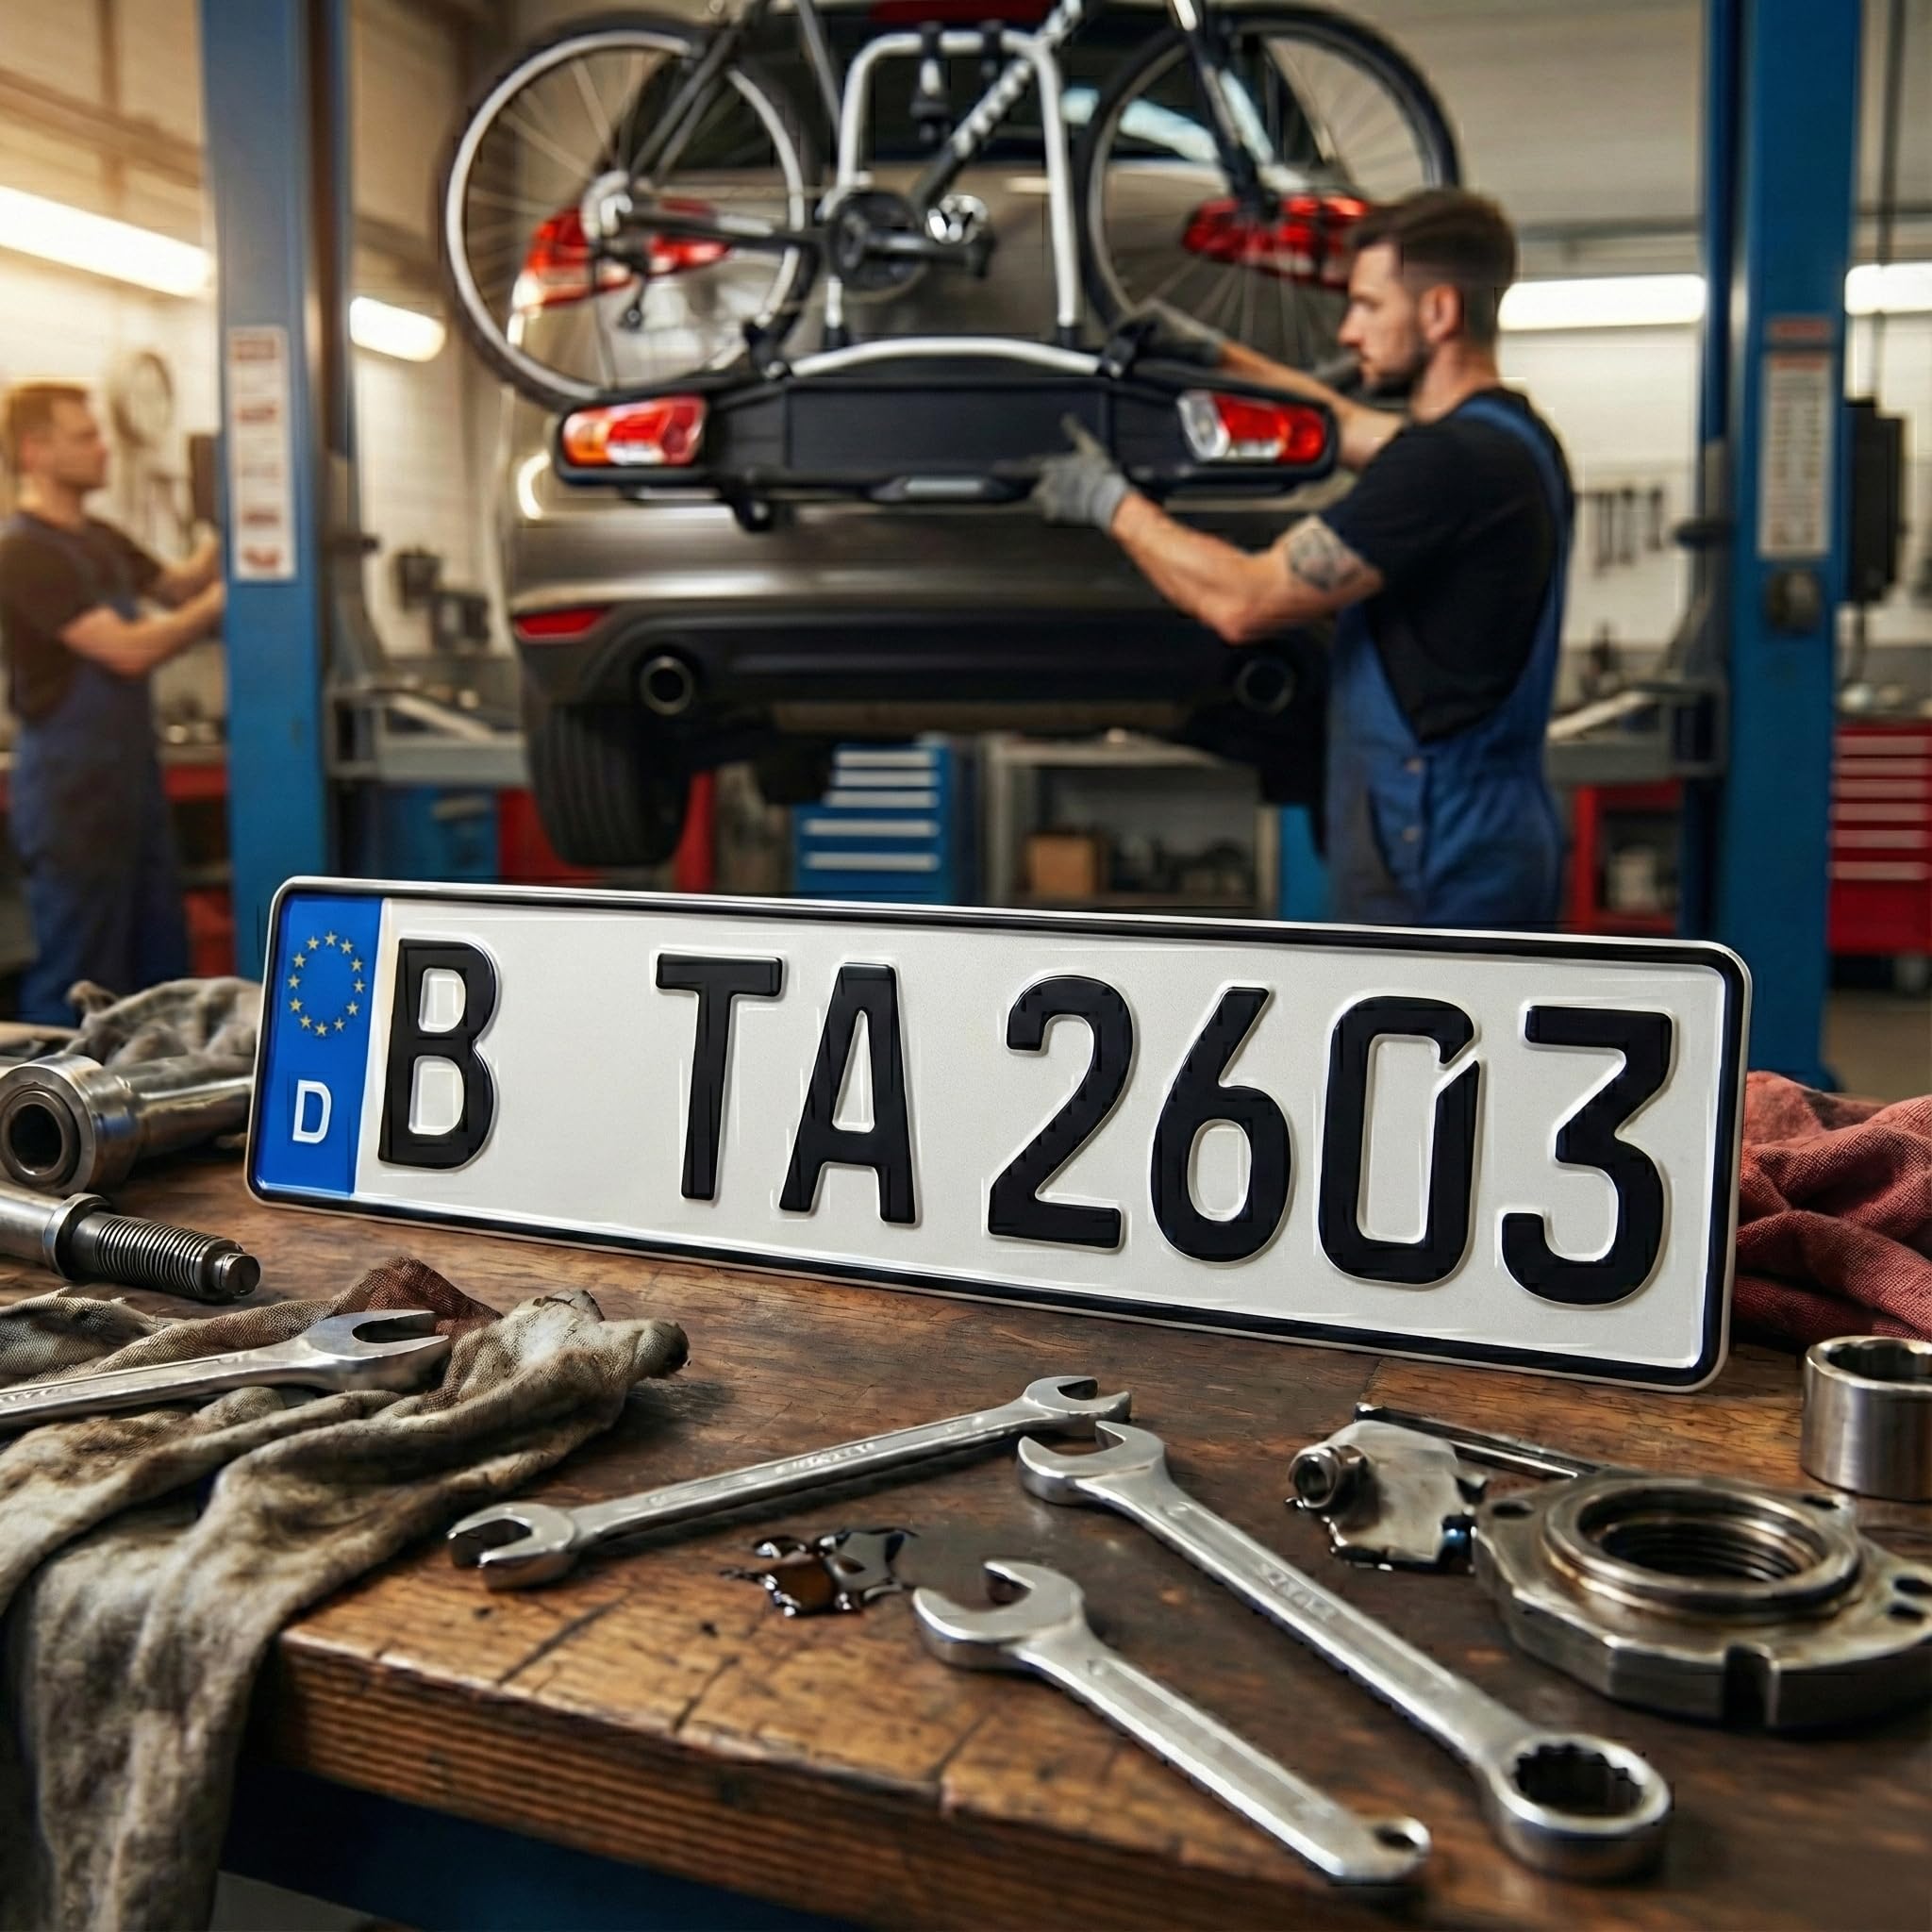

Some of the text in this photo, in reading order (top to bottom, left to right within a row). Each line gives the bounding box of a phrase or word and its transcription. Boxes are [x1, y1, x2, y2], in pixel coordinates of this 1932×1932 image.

[292, 1079, 332, 1144] D
[377, 938, 1673, 1305] B TA 2603
